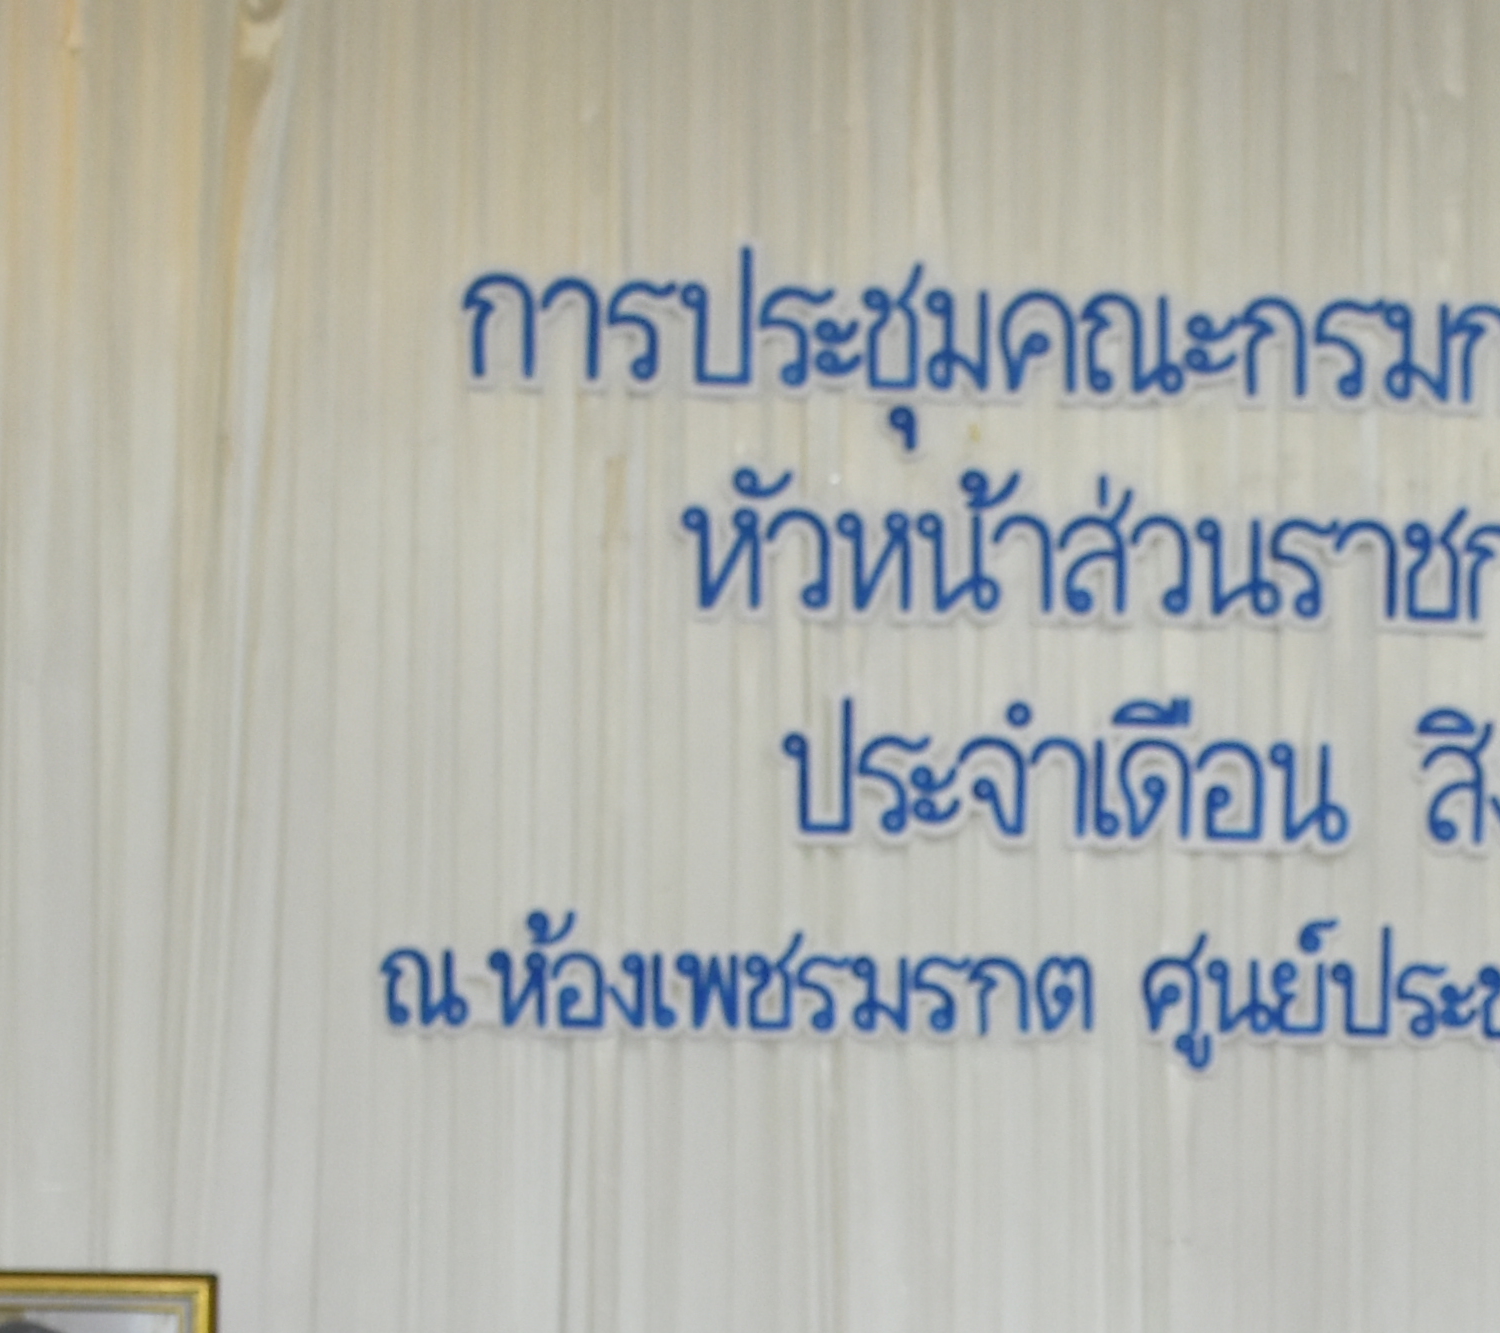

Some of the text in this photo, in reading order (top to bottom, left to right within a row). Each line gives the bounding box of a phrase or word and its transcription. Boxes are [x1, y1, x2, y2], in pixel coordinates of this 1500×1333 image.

[781, 696, 1353, 845] ประจำเดือน
[380, 946, 471, 1028] ณ
[487, 909, 1095, 1035] ห้องเพชรมรกต
